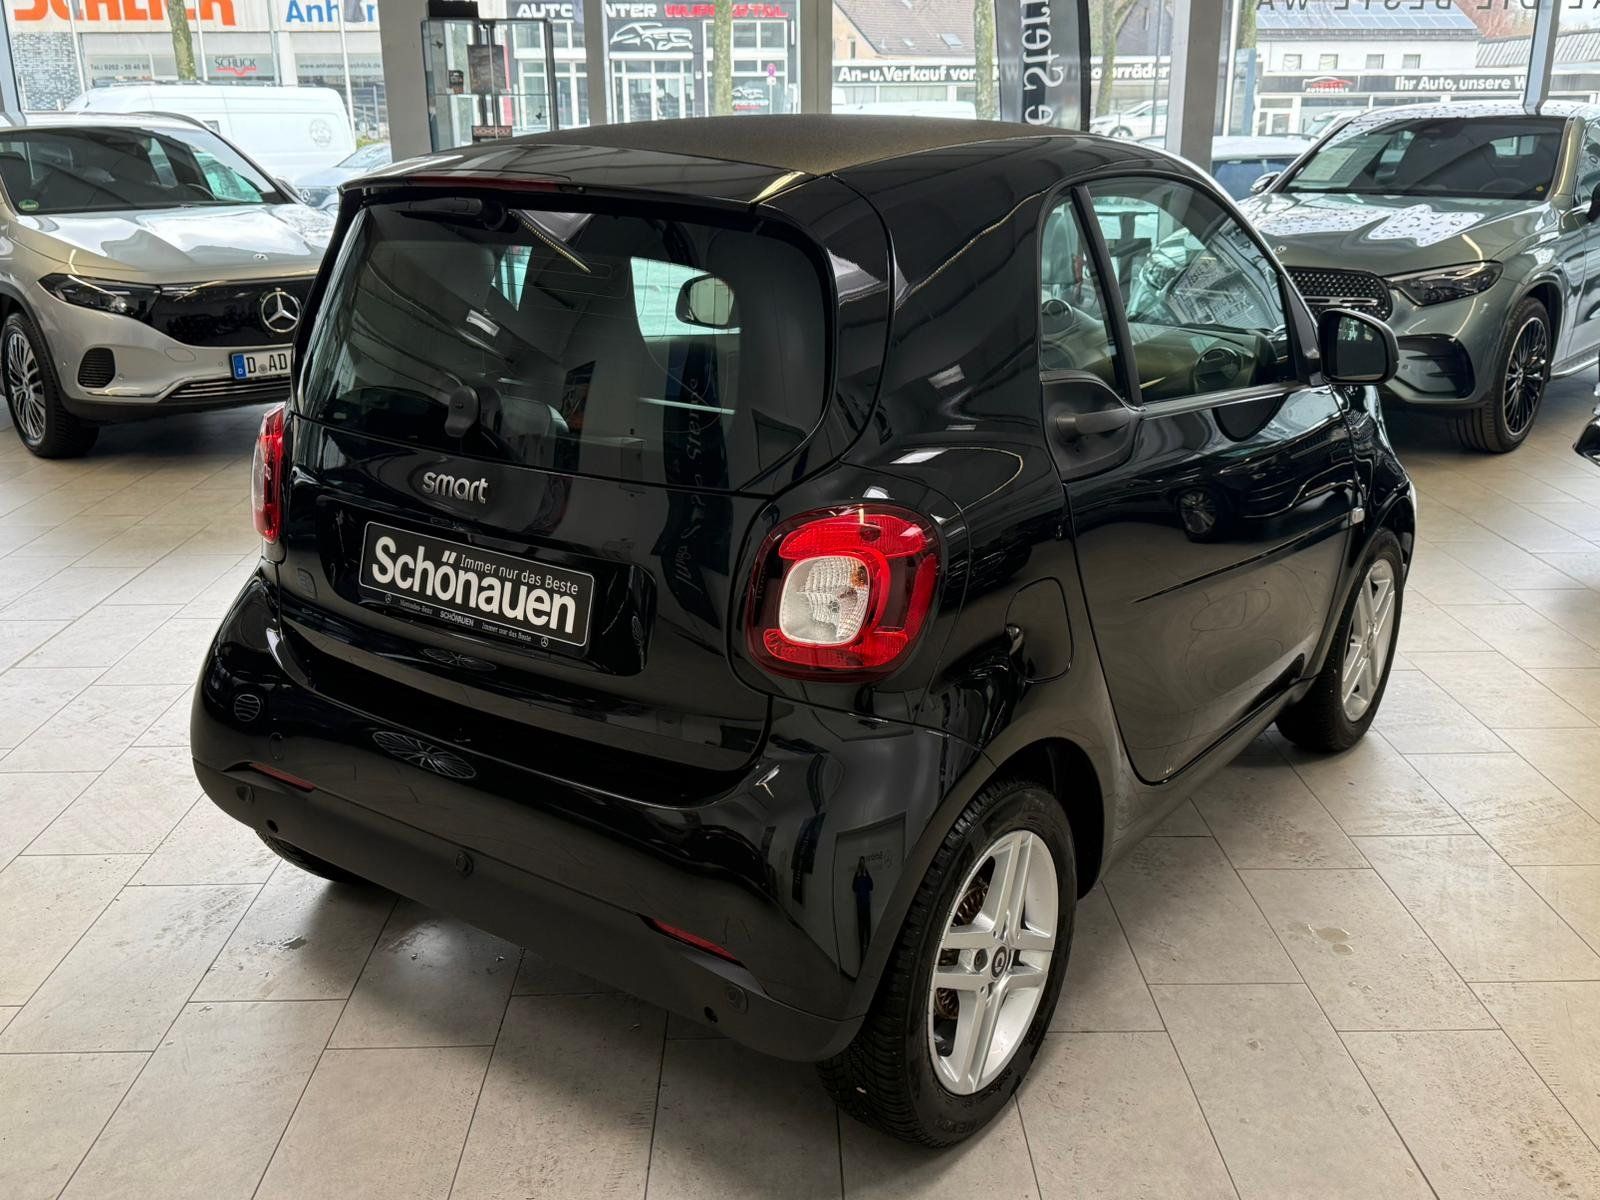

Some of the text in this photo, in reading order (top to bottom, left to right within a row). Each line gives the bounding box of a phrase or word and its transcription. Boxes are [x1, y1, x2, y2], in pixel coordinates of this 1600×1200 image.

[605, 3, 658, 18] NTER
[1394, 76, 1417, 91] Ihr
[1417, 76, 1457, 91] Auto,
[1458, 79, 1512, 91] unsere
[246, 356, 257, 374] D
[422, 471, 490, 504] smart
[460, 553, 579, 595] Immer nur das Beste
[371, 535, 577, 635] Schönauen
[439, 610, 475, 628] SCHÖNAUEN
